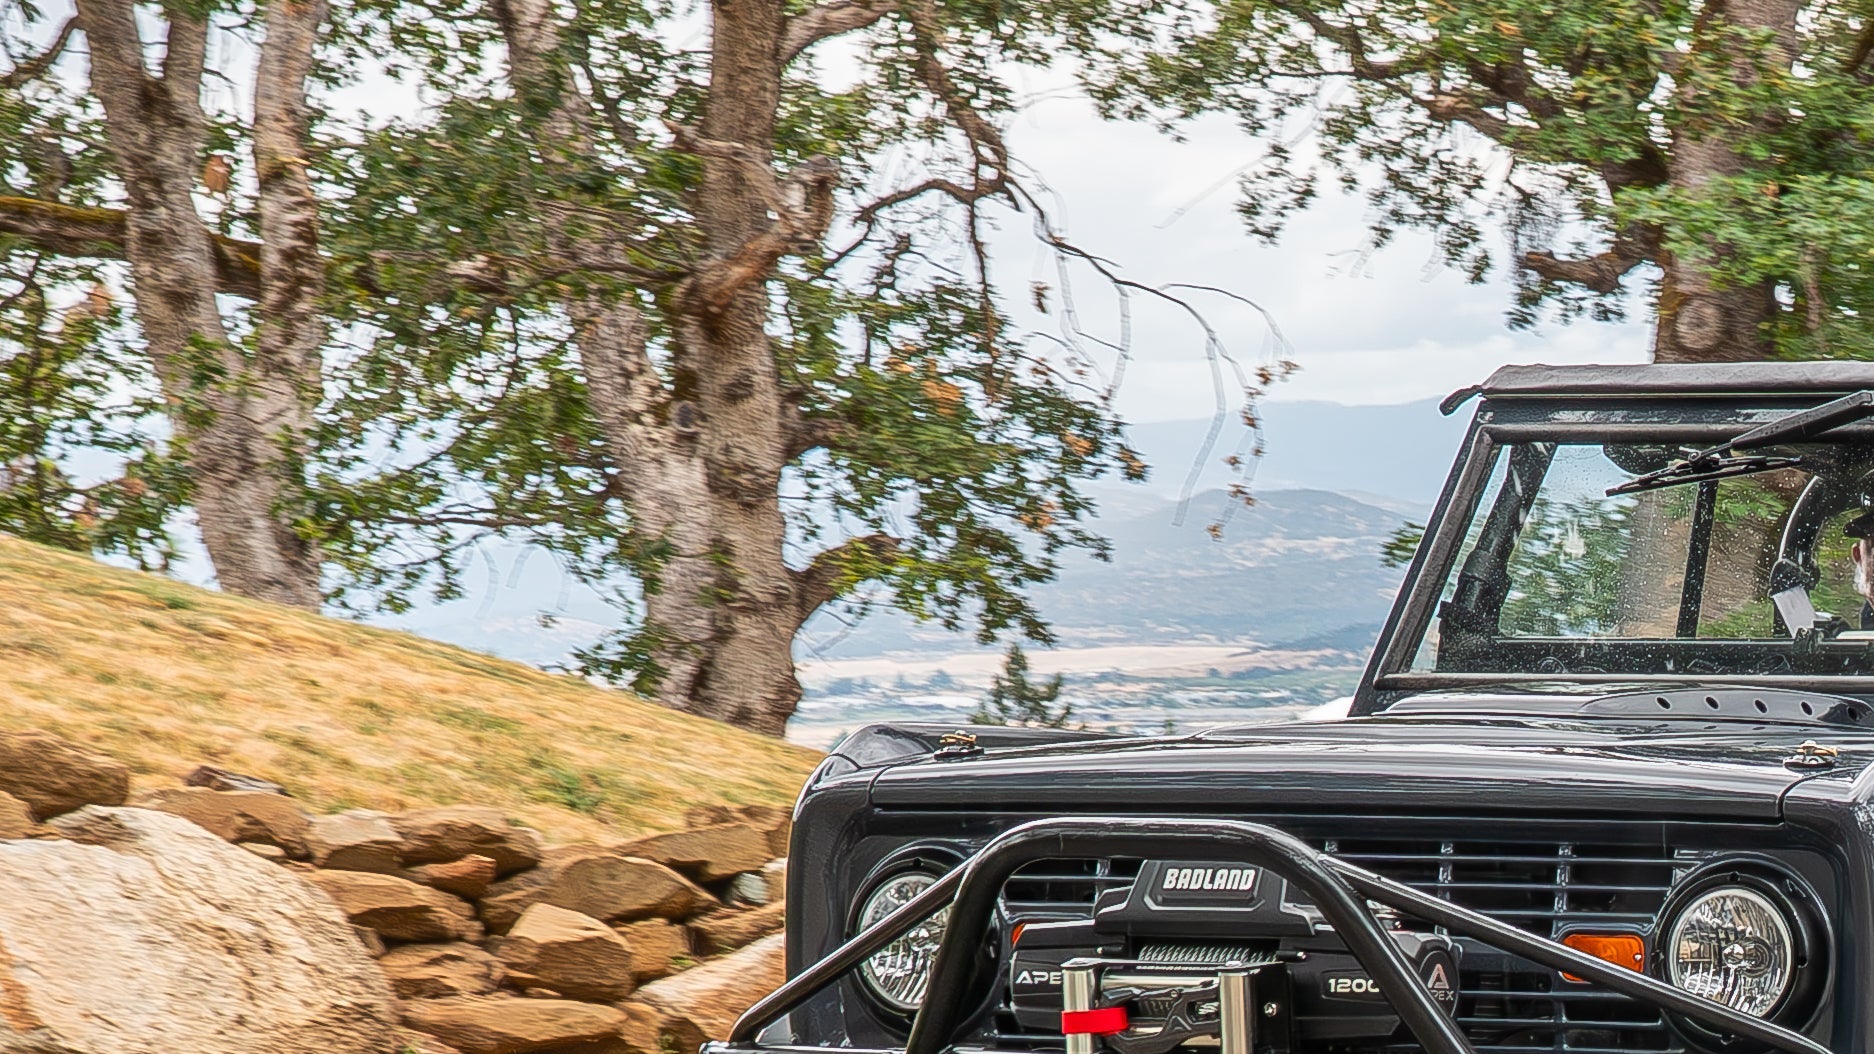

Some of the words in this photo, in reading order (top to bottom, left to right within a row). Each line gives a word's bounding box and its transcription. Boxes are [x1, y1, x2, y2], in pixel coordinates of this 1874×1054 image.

[1163, 868, 1256, 890] BADLAND
[1015, 970, 1062, 985] APE
[1328, 978, 1380, 993] 1200
[1429, 988, 1455, 1001] PEX
